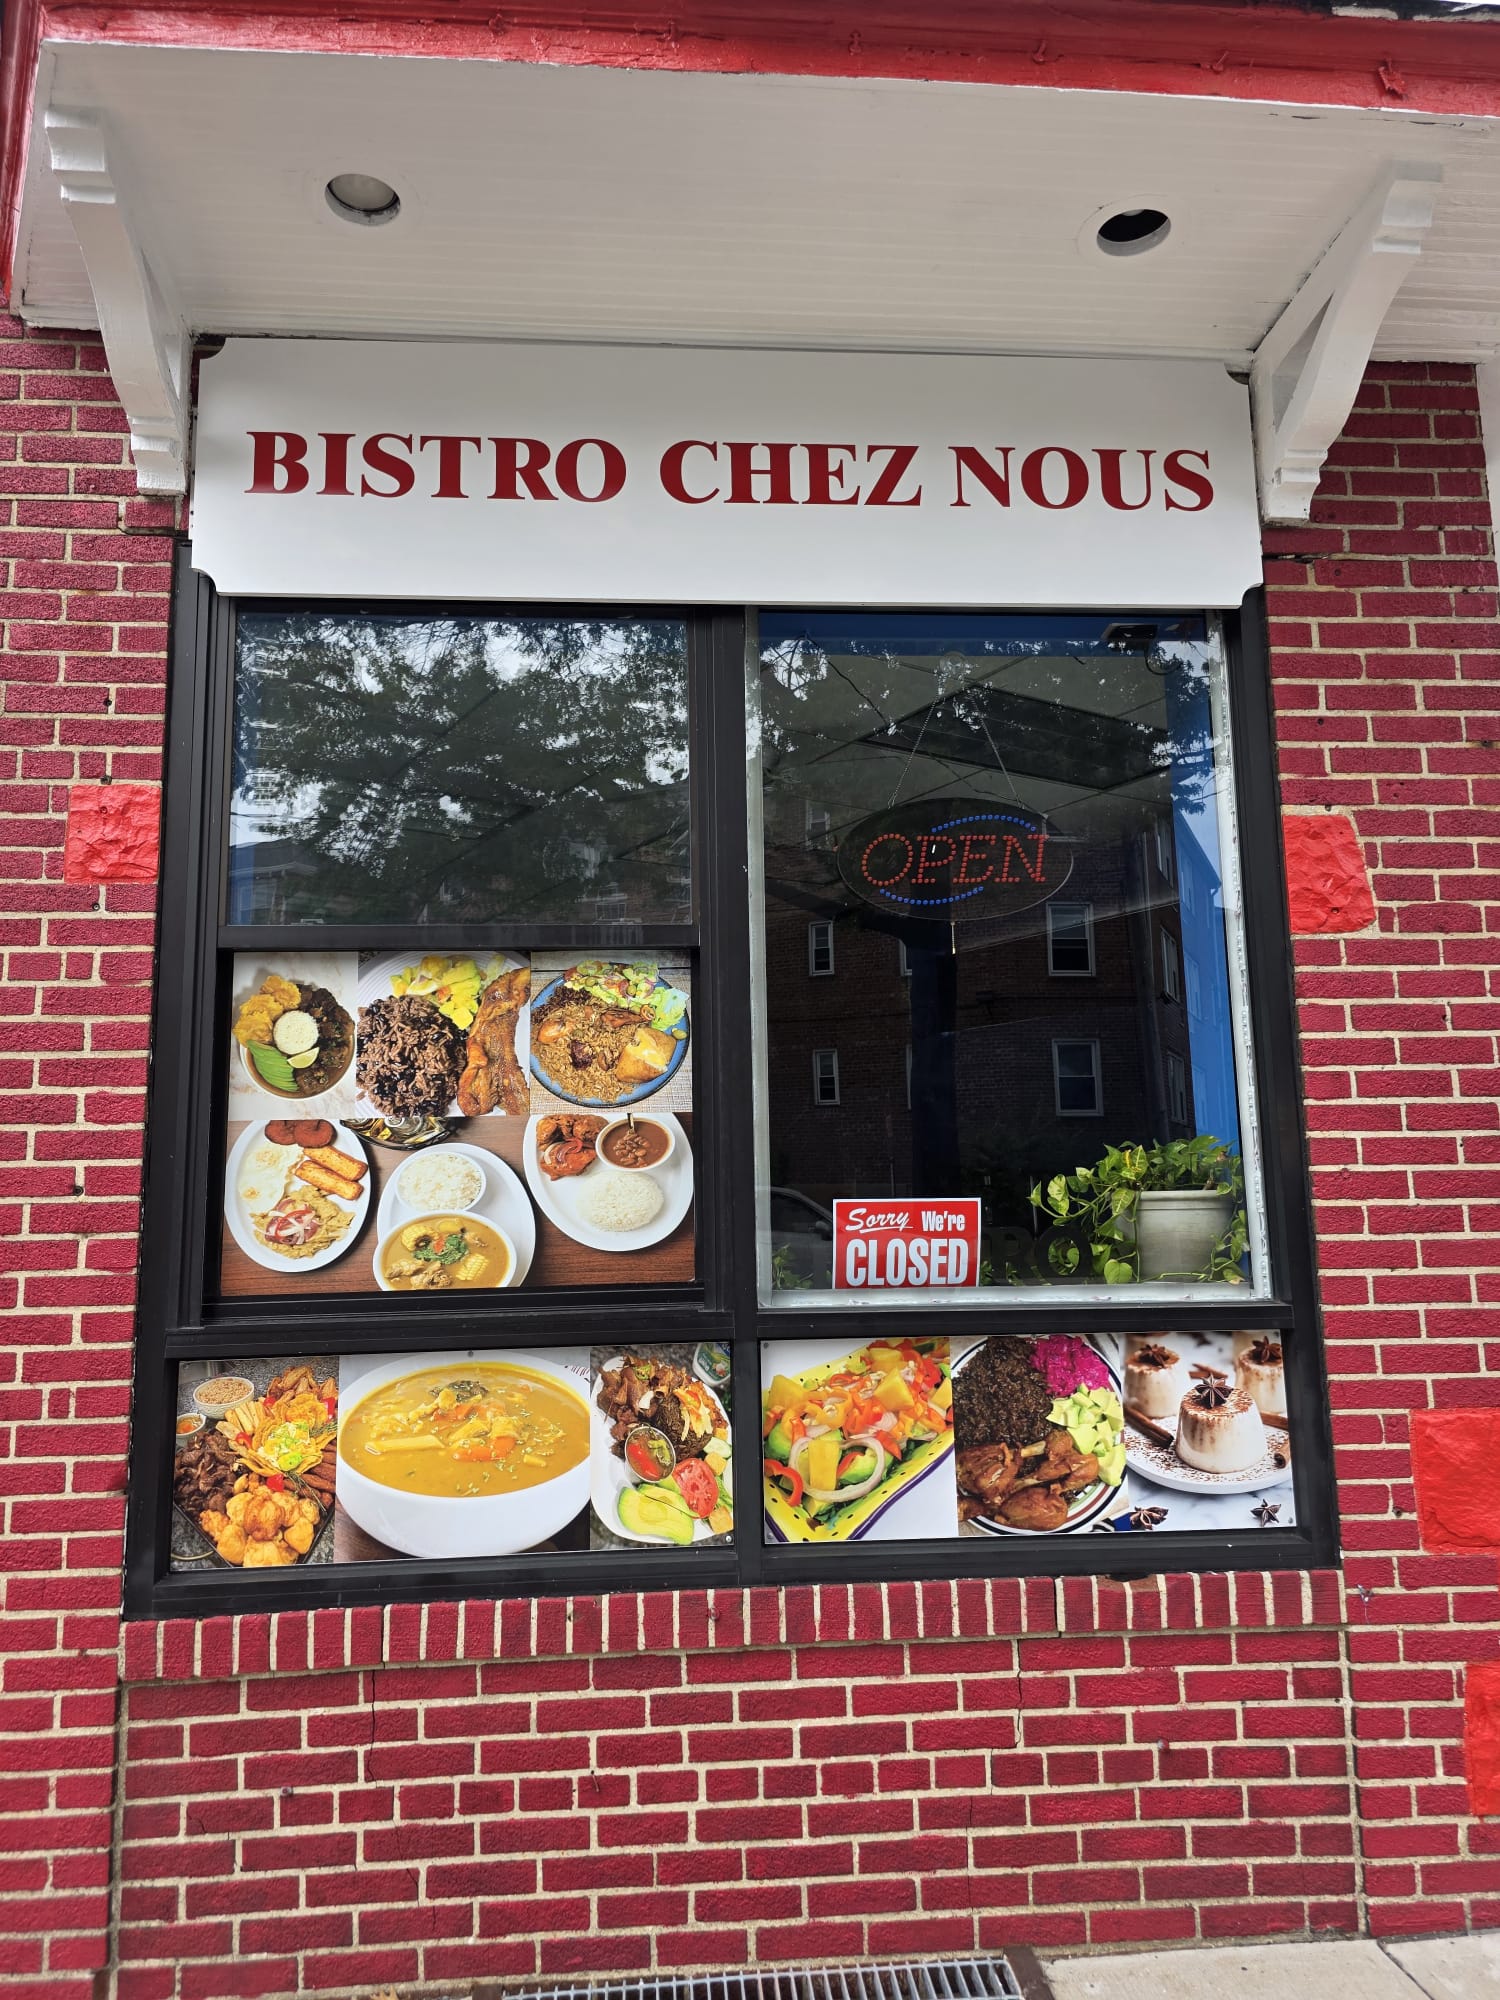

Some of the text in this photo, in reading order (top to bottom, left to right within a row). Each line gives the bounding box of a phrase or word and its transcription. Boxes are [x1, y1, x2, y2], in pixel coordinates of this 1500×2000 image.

[245, 431, 1215, 511] BISTRO CHEZ NOUS
[861, 833, 1050, 886] OPEN
[845, 1207, 966, 1233] Sorry We're
[845, 1237, 969, 1287] CLOSED
